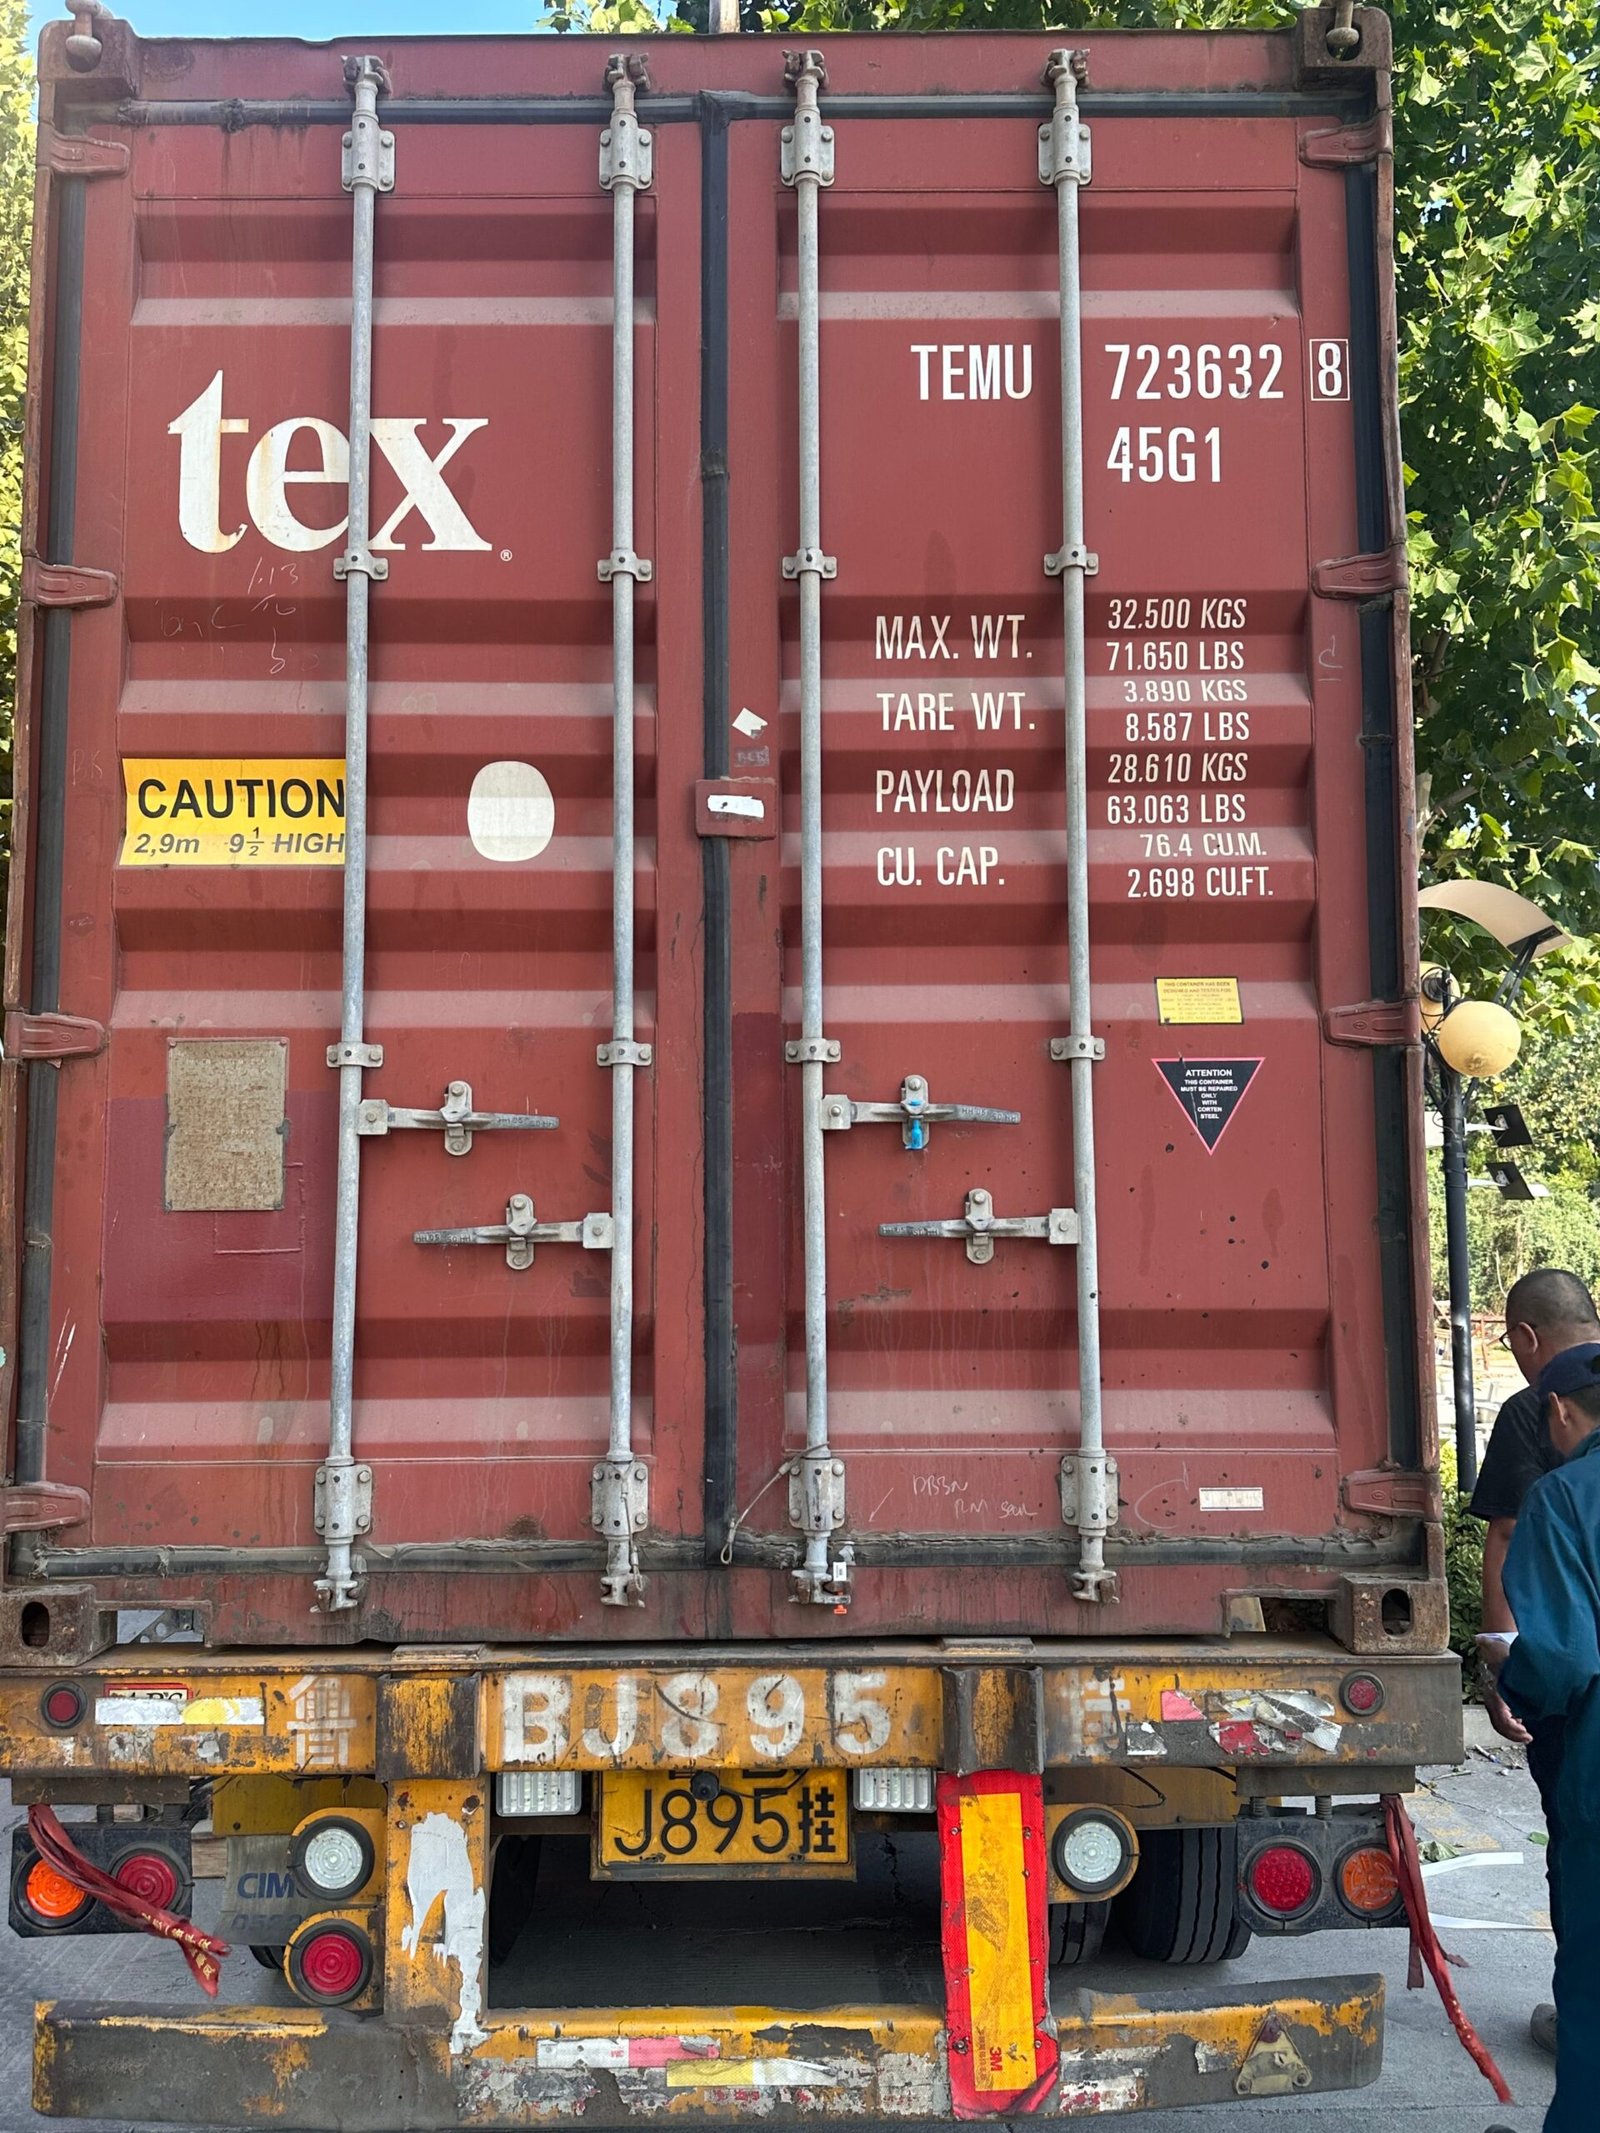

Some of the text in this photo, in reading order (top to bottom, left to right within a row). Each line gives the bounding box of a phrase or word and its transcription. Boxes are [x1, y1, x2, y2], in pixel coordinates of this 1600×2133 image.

[911, 342, 1342, 400] TEMU 723632 8
[167, 369, 493, 554] tex
[1107, 426, 1221, 483] 45G1
[1200, 598, 1247, 629] KGS
[875, 614, 1033, 660] MAX. WT.
[1199, 641, 1244, 670] LBS
[1200, 679, 1248, 702] KGS
[876, 691, 1035, 731] TARE WT.
[1203, 711, 1250, 741] LBS
[1201, 752, 1248, 782] KGS
[138, 778, 345, 819] CAUTION
[876, 769, 1014, 813] PAYLOAD
[1200, 794, 1246, 823] LBS
[134, 832, 200, 857] 2,9m
[274, 832, 345, 854] HIGH
[1139, 831, 1268, 858] 76.4 CU.M.
[876, 846, 1005, 886] CU. CAP.
[1206, 866, 1274, 897] CU.FT.
[1185, 1069, 1233, 1077] ATTENTION
[503, 1672, 892, 1763] BJ895
[237, 1872, 307, 1899] CIM
[989, 2046, 1003, 2072] 3M
